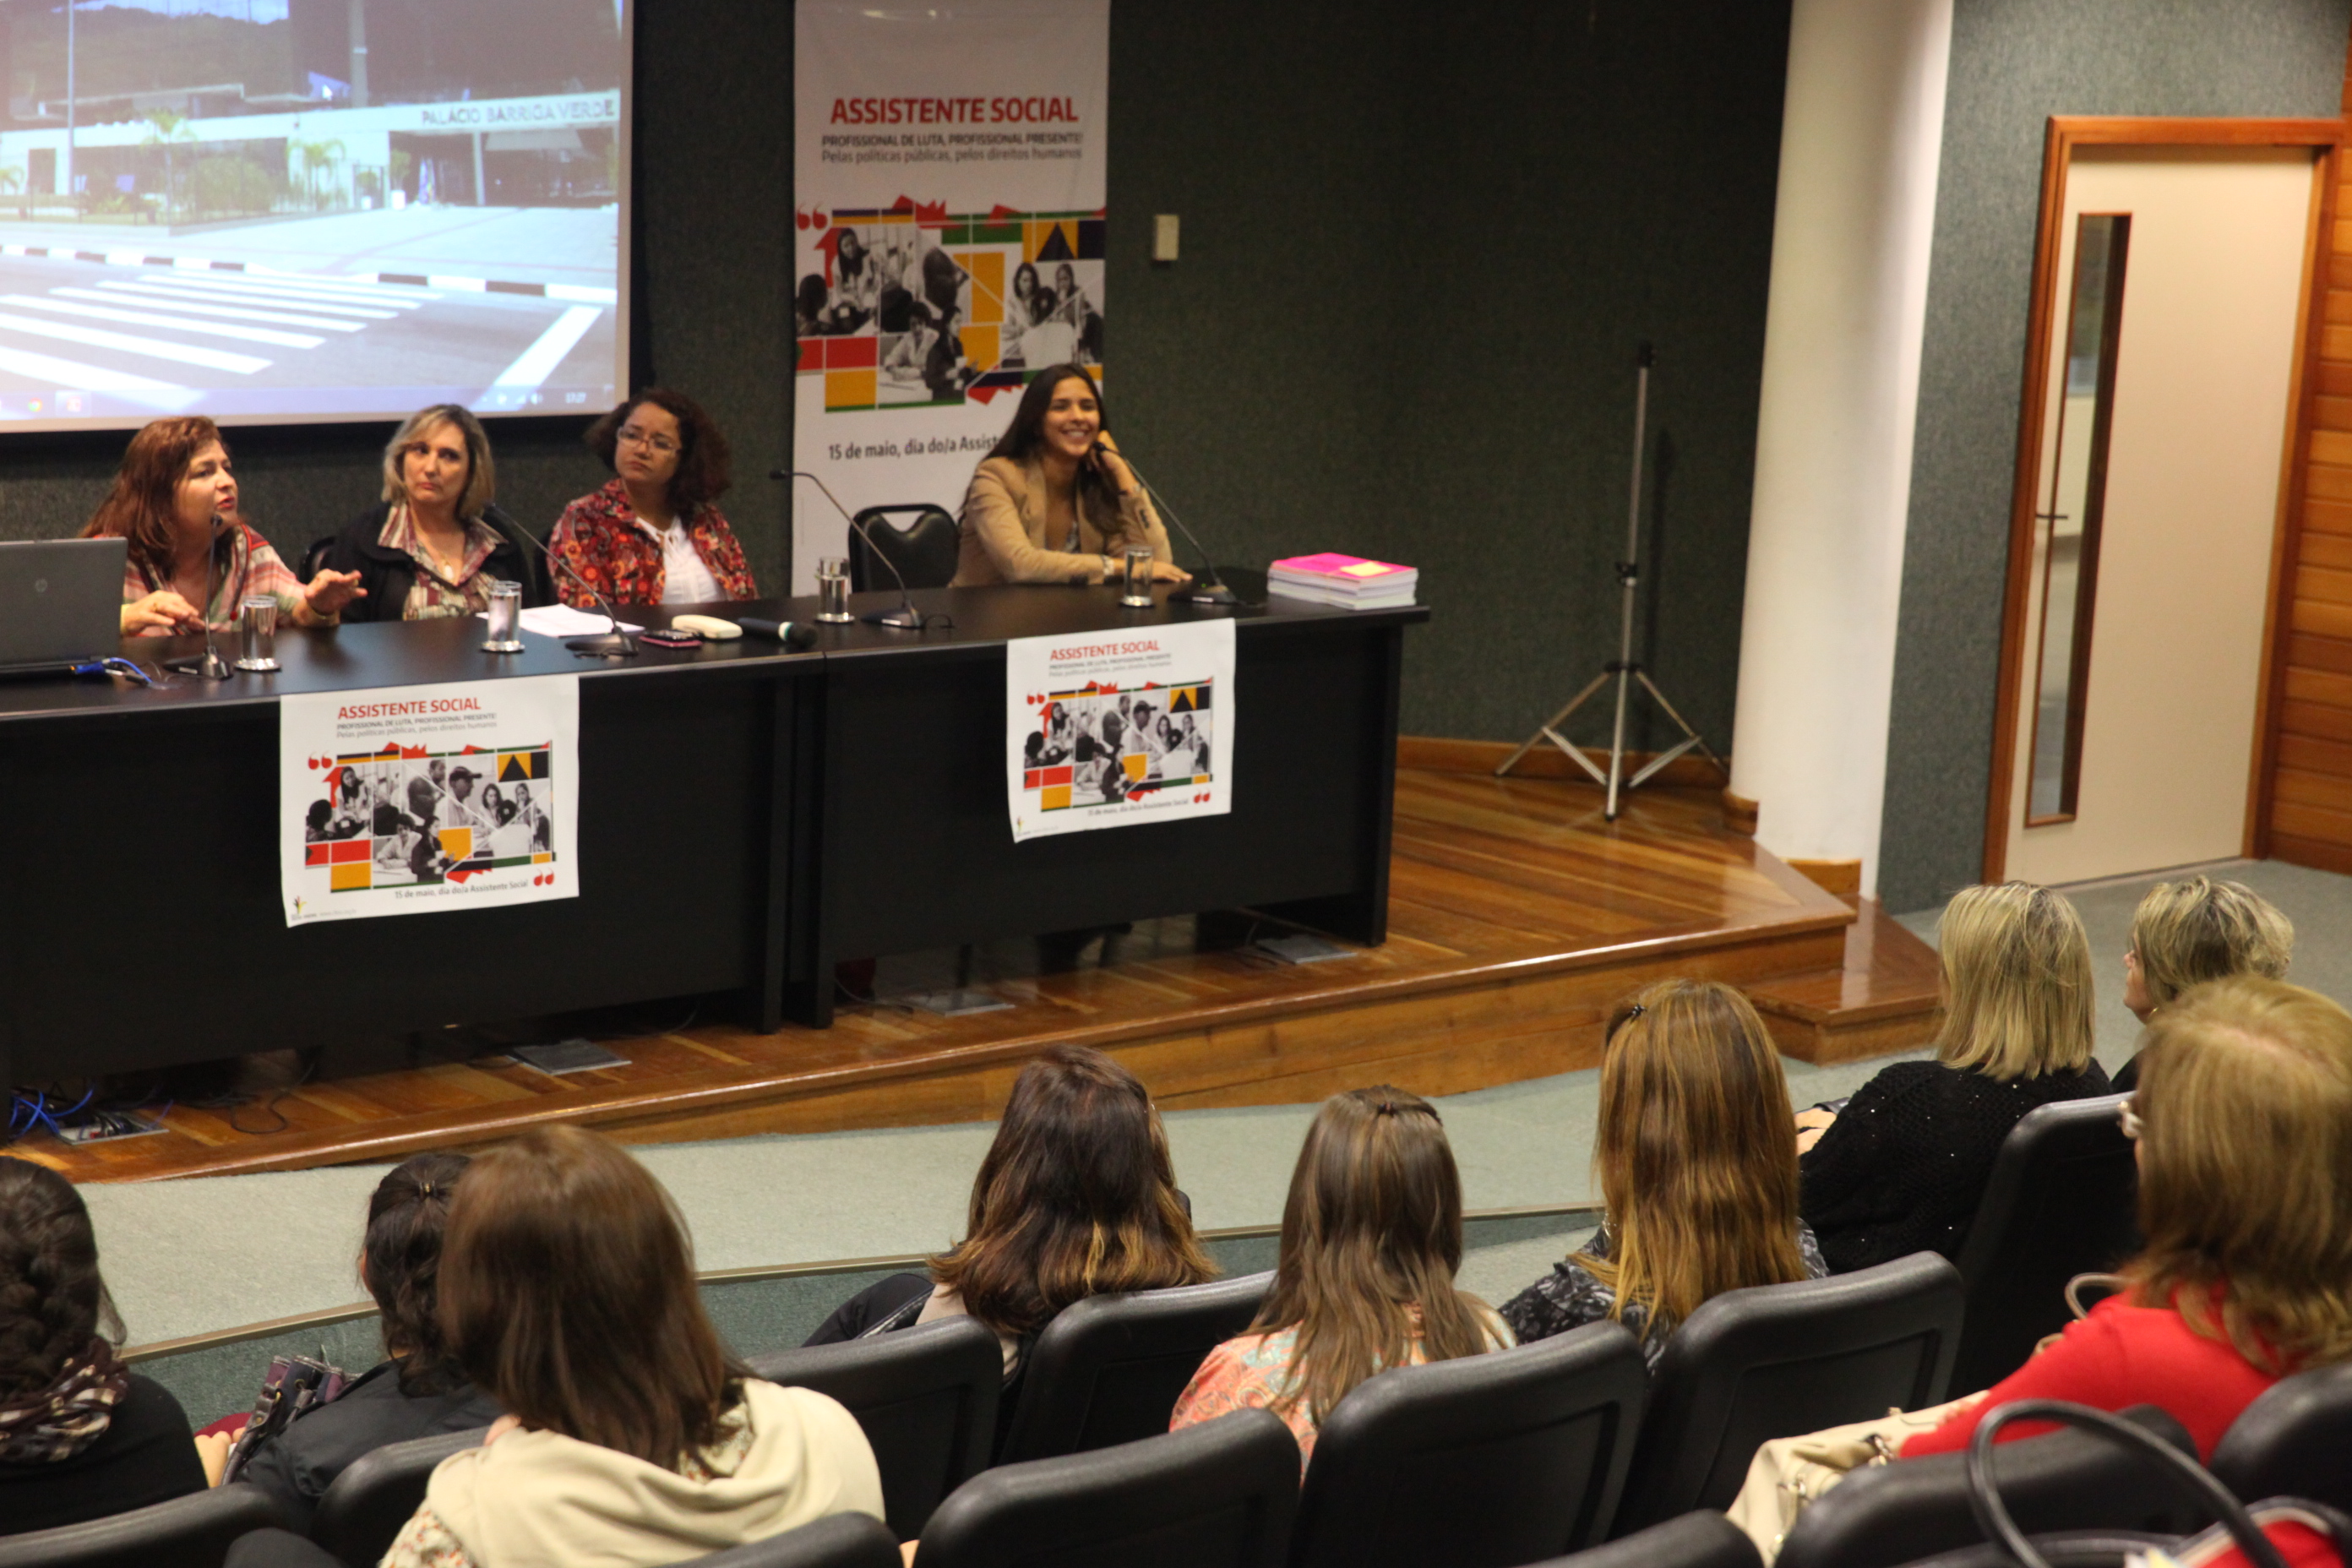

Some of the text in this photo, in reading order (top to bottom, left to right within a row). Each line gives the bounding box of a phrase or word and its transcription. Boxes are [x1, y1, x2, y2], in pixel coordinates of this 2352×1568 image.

[422, 99, 615, 124] PALÁCIO BARRIGA VERDE
[830, 96, 1080, 124] ASSISTENTE SOCIAL
[821, 134, 898, 147] PROFISSIONAL
[901, 133, 914, 146] DE
[917, 133, 946, 147] LUTA,
[948, 133, 1022, 145] PROFISSIONAL
[821, 149, 853, 163] Pelas
[955, 147, 984, 164] pelos
[987, 147, 1030, 161] direitos
[1031, 146, 1082, 161] humanos
[829, 433, 999, 460] 15 de maio, dia do/a Assist
[1050, 640, 1160, 661] ASSISTENTE SOCIAL
[338, 697, 482, 719] ASSISTENTE SOCIAL
[336, 730, 356, 738] Pelas
[419, 724, 438, 734] pelos
[439, 722, 466, 732] direitos
[467, 720, 498, 729] humanos
[337, 720, 384, 730] PROFISSIONAL
[385, 719, 395, 727] DE
[415, 715, 461, 724] PROFISSIONAL
[395, 879, 529, 899] 15 de maio, dia do/a Assistente Social
